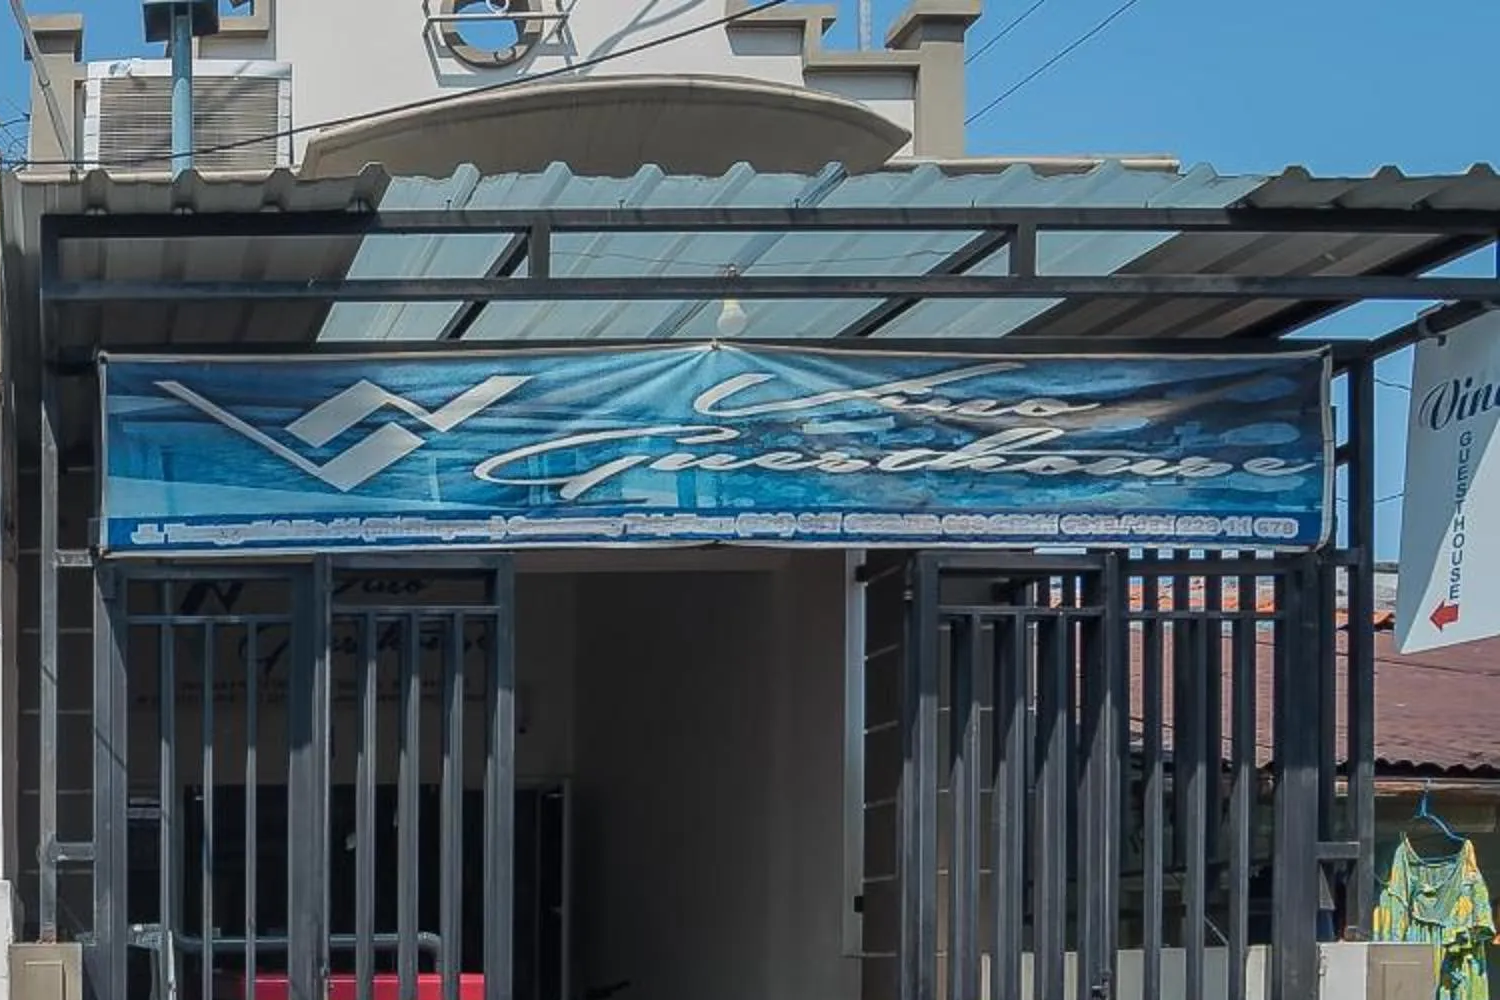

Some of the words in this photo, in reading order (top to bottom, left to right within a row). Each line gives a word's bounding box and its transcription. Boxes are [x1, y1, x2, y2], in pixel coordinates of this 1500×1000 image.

[693, 361, 1101, 417] Vino
[1418, 376, 1500, 431] Vin
[472, 424, 1317, 500] Guesthouse
[1449, 431, 1473, 600] GUESTHOUSE
